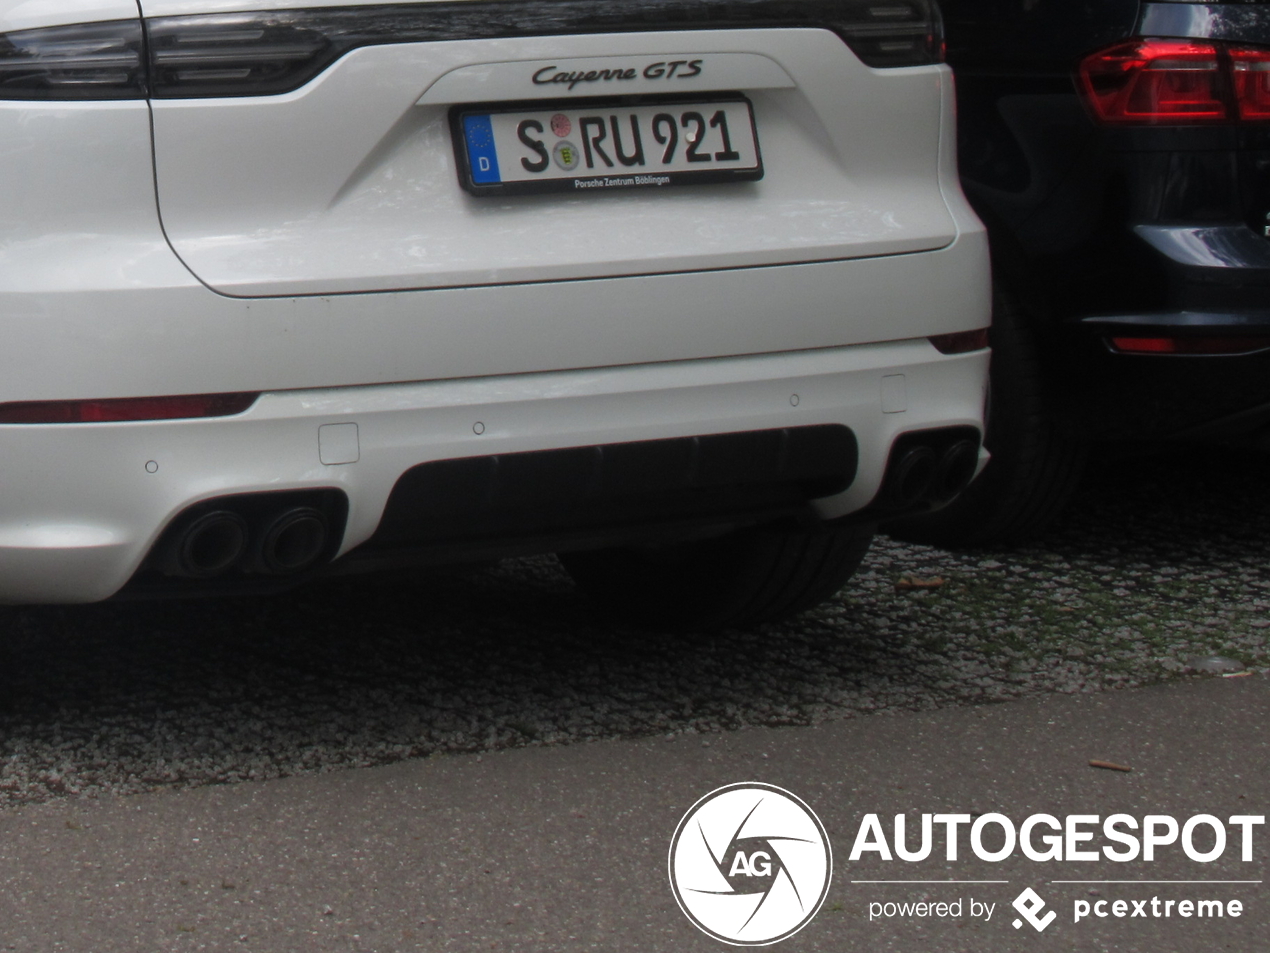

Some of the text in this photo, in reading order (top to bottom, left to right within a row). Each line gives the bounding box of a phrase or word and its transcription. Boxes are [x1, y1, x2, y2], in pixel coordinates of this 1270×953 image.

[532, 59, 703, 90] Cayenne GTS
[517, 110, 740, 173] S RU 921
[479, 157, 490, 172] D
[574, 176, 670, 188] Porsche Zentrum Böblingen
